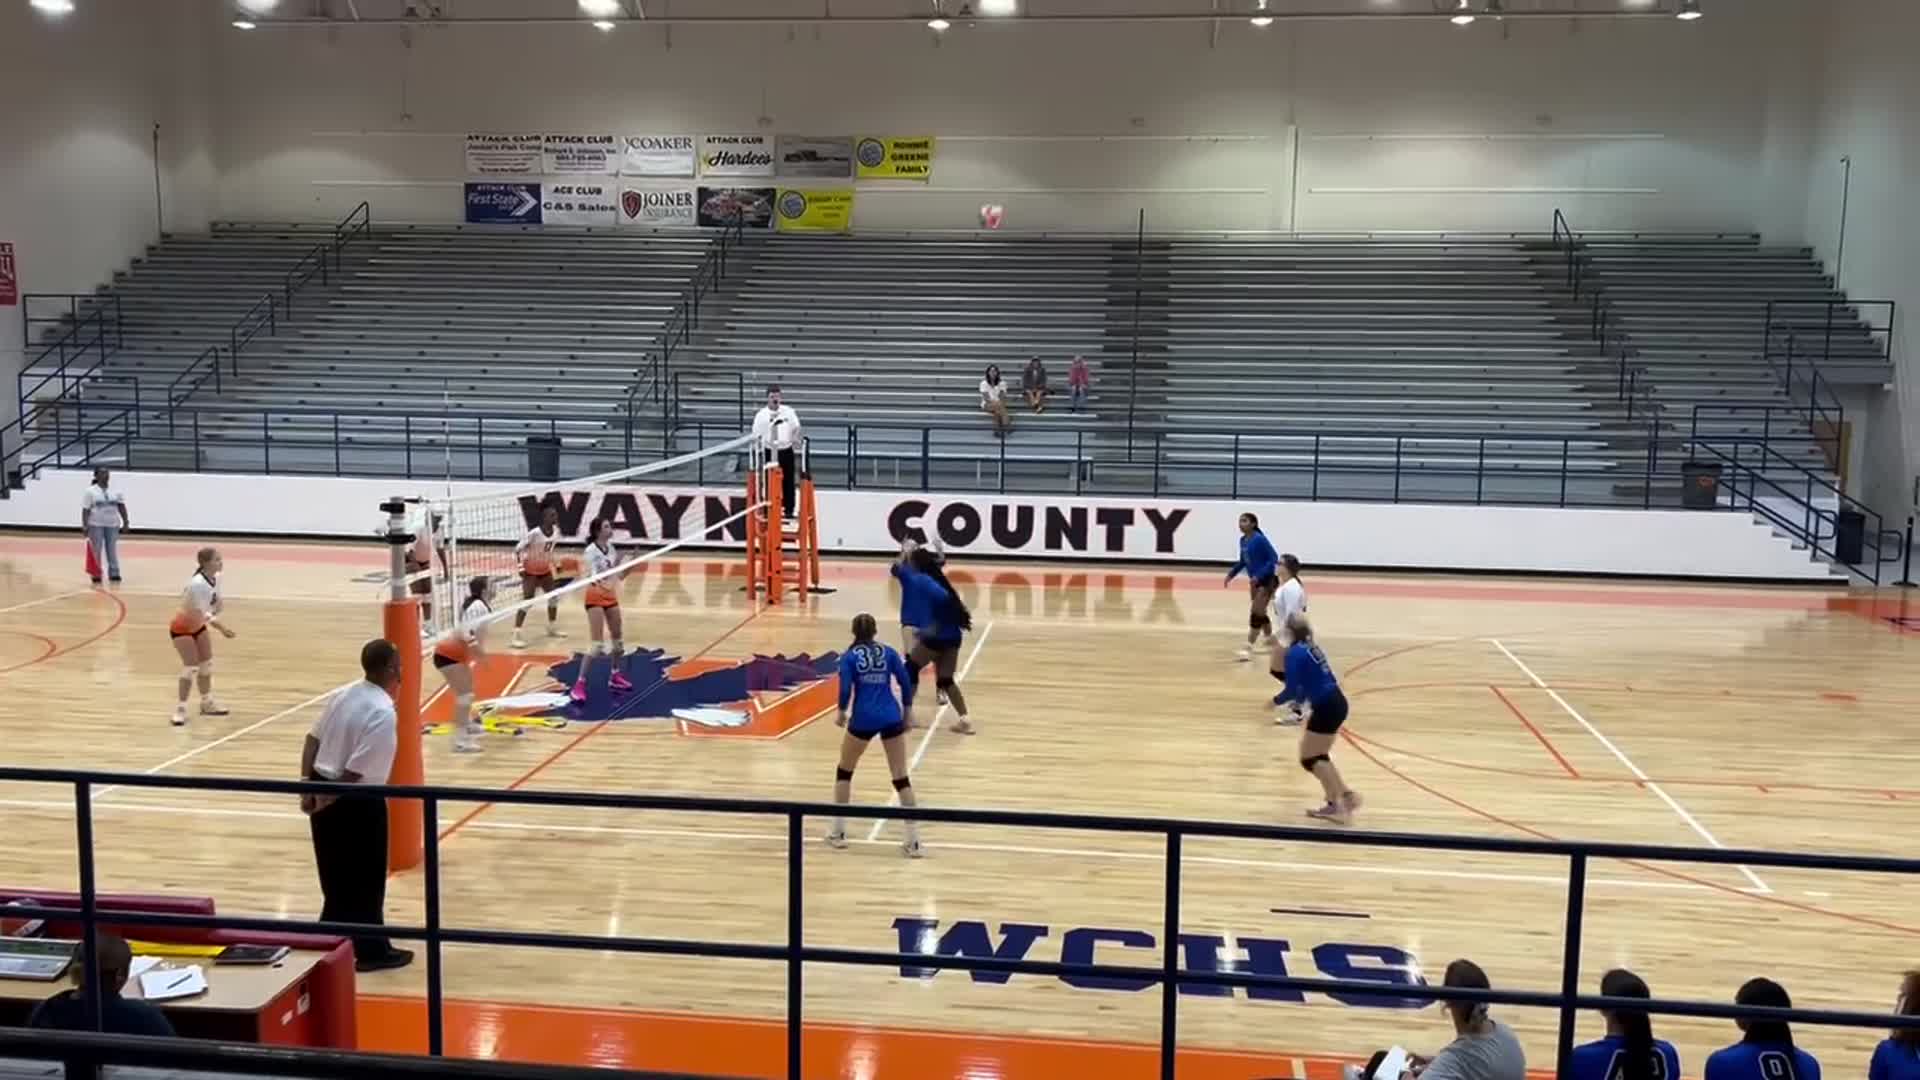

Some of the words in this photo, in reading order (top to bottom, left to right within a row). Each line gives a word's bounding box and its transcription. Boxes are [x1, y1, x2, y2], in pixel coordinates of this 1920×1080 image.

[544, 136, 584, 144] ATTACK
[587, 136, 614, 144] CLUB
[630, 136, 692, 150] COAKER
[706, 136, 739, 144] ATTACK
[741, 136, 764, 144] CLUB
[896, 164, 929, 174] FAMILY
[553, 186, 573, 194] ACE
[576, 187, 603, 196] CLUB
[468, 192, 490, 205] First
[491, 193, 518, 205] State
[642, 192, 693, 209] JOINER
[643, 207, 693, 218] INSURANCE
[517, 490, 747, 542] WAYN
[887, 499, 1191, 554] COUNTY
[852, 642, 887, 673] 32
[891, 917, 1439, 1009] WCHS
